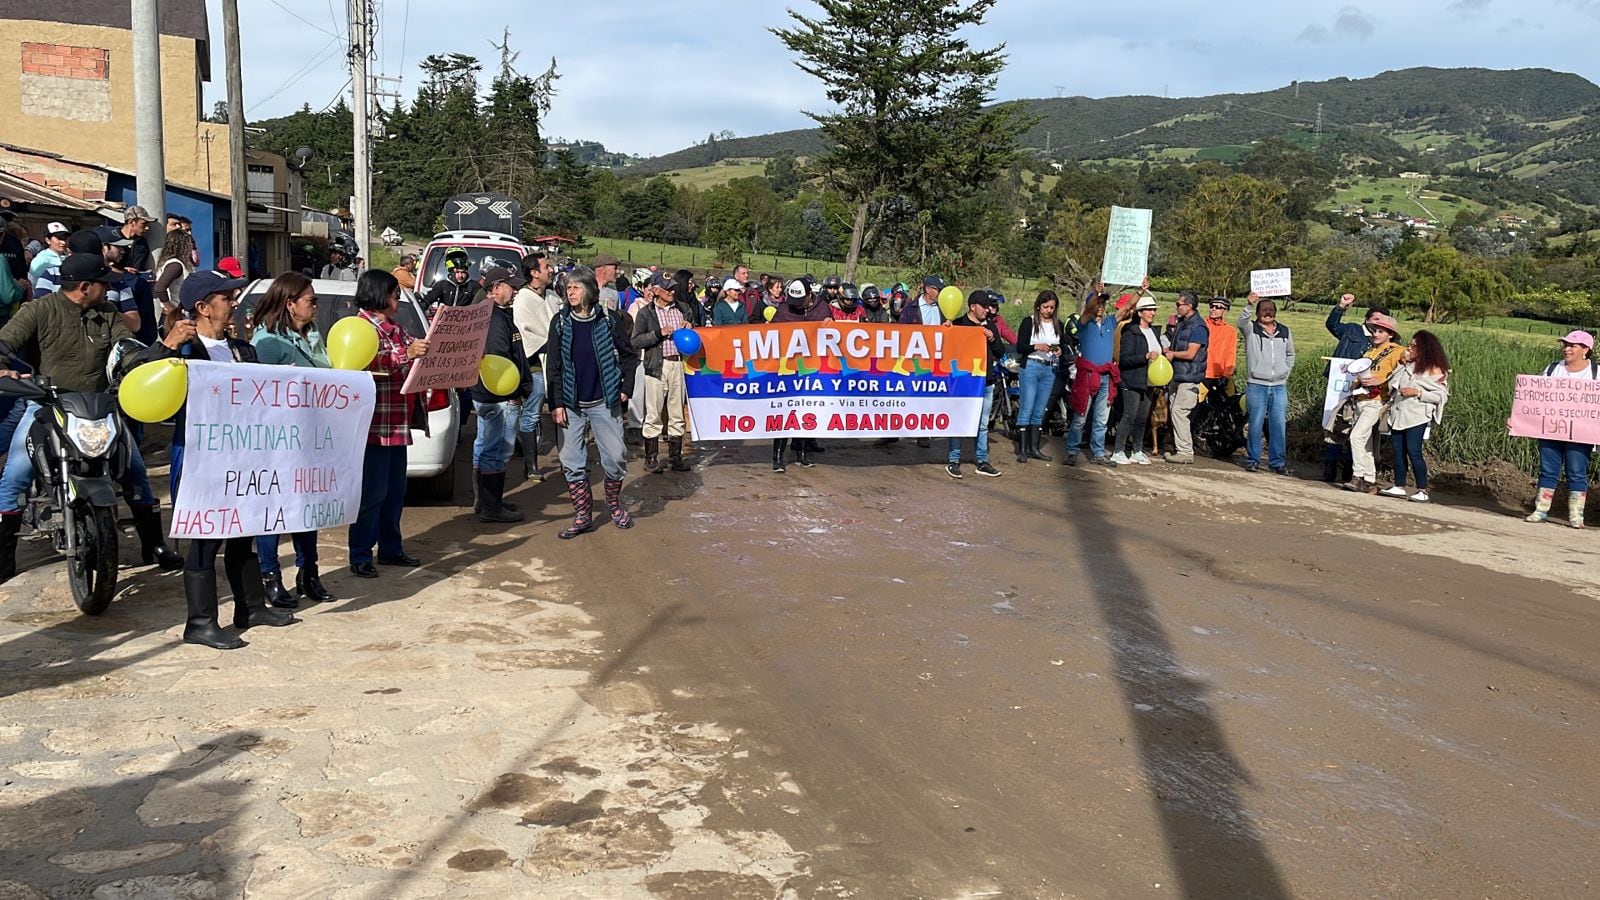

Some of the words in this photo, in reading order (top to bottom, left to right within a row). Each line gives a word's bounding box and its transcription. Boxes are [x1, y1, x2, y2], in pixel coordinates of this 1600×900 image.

[732, 328, 945, 368] ¡MARCHA!
[231, 377, 349, 409] EXIGIMOS
[722, 382, 760, 395] POR
[766, 380, 787, 393] LA
[792, 376, 824, 392] VÍA
[830, 378, 842, 392] Y
[847, 379, 879, 393] POR
[885, 379, 906, 392] LA
[911, 380, 949, 393] VIDA
[1516, 377, 1528, 388] NO
[1530, 377, 1553, 389] MAS
[1568, 379, 1582, 391] LO
[1523, 390, 1565, 401] PROYECTO
[770, 401, 783, 409] La
[787, 399, 826, 408] Calera
[858, 399, 869, 407] El
[872, 399, 907, 408] Codito
[1522, 405, 1542, 416] QUE
[1544, 408, 1556, 416] LO
[719, 415, 756, 433] NO
[765, 409, 818, 432] MÁS
[827, 413, 950, 430] ABANDONO
[193, 423, 301, 451] TERMINAR
[314, 425, 334, 450] LA
[225, 469, 281, 496] PLACA
[294, 467, 338, 495] HUELLA
[174, 508, 243, 535] HASTA
[264, 506, 286, 532] LA
[303, 499, 345, 529] CABAÑA
